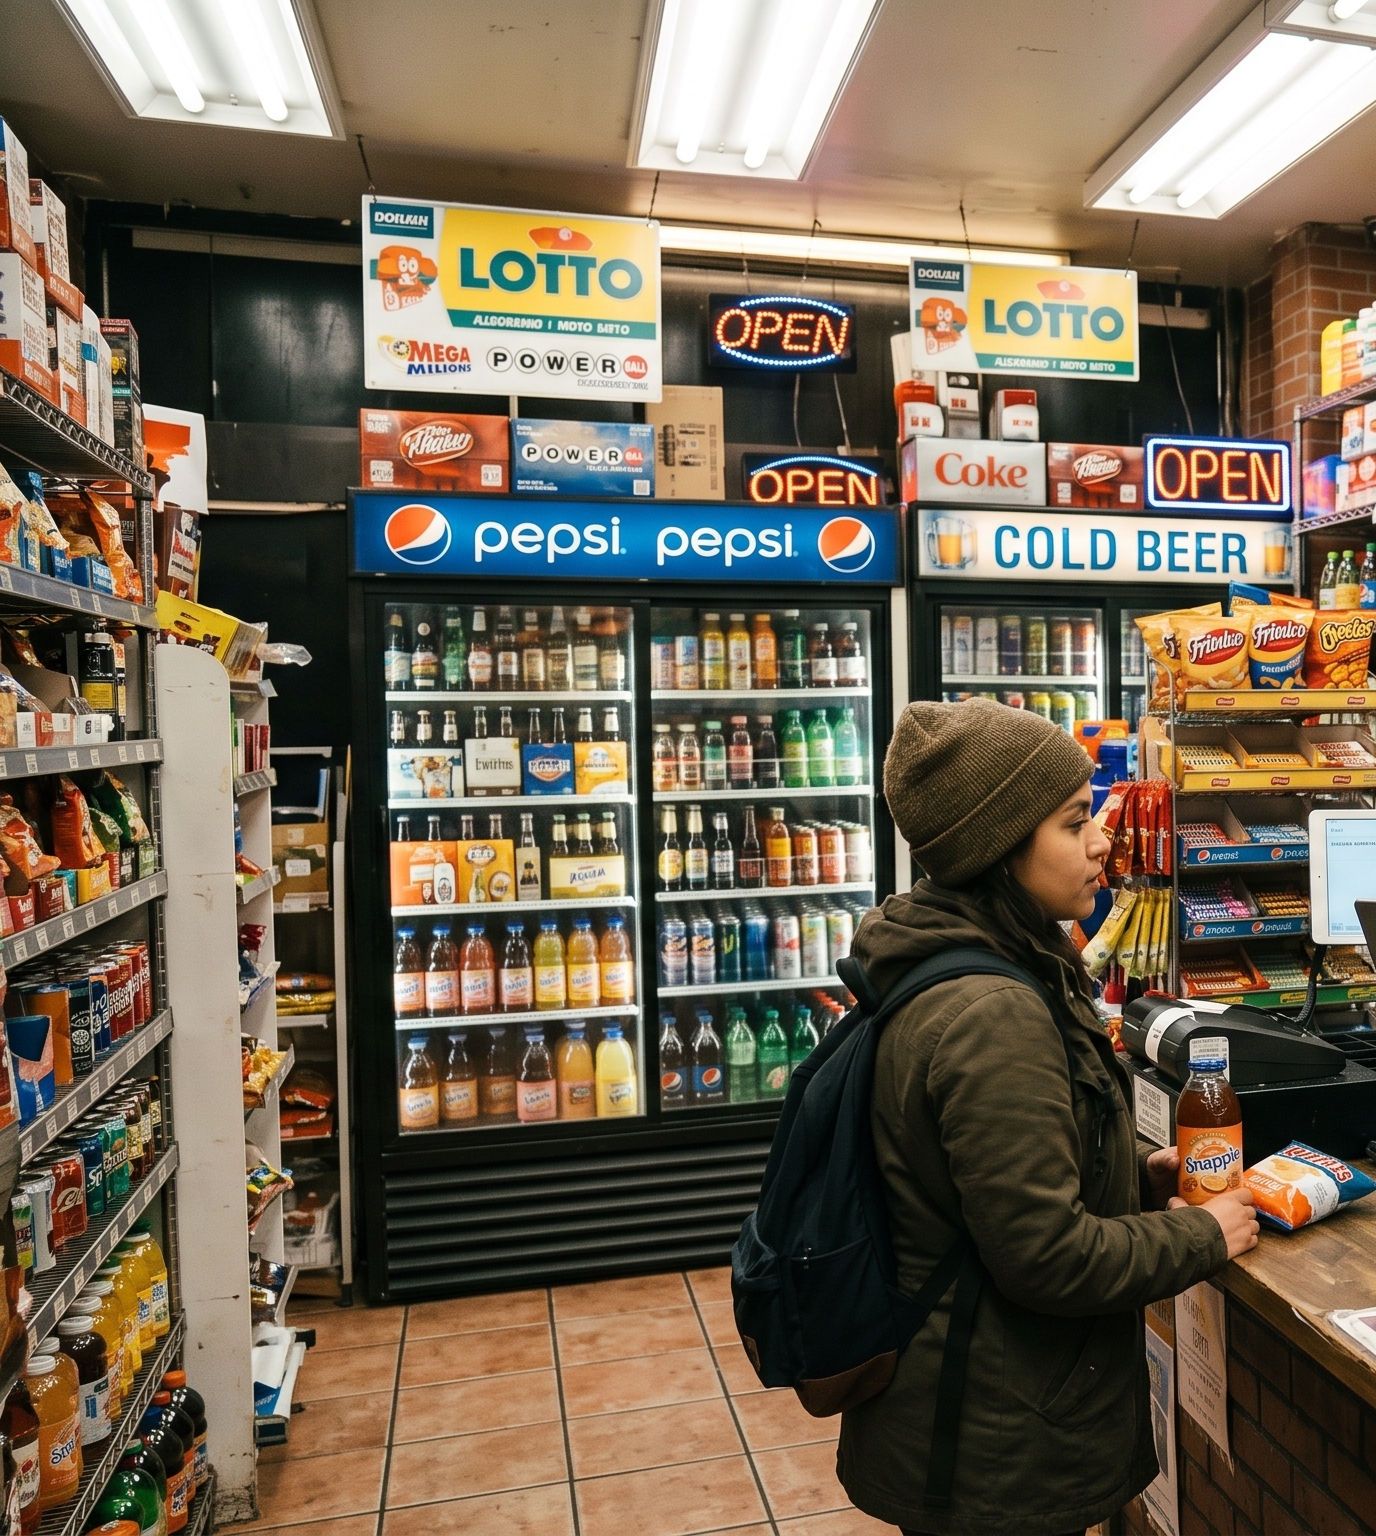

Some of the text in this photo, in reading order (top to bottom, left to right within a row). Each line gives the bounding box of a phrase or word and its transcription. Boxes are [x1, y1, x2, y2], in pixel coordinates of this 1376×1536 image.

[460, 247, 643, 300] LOTTO
[716, 308, 849, 356] OPEN
[984, 299, 1124, 341] LOTTO
[407, 340, 471, 363] MEGA
[493, 351, 617, 375] POWER
[526, 446, 620, 462] POWER
[935, 453, 1028, 489] Coke
[750, 469, 878, 505] OPEN
[1155, 447, 1281, 503] OPEN
[994, 525, 1248, 575] COLD BEER
